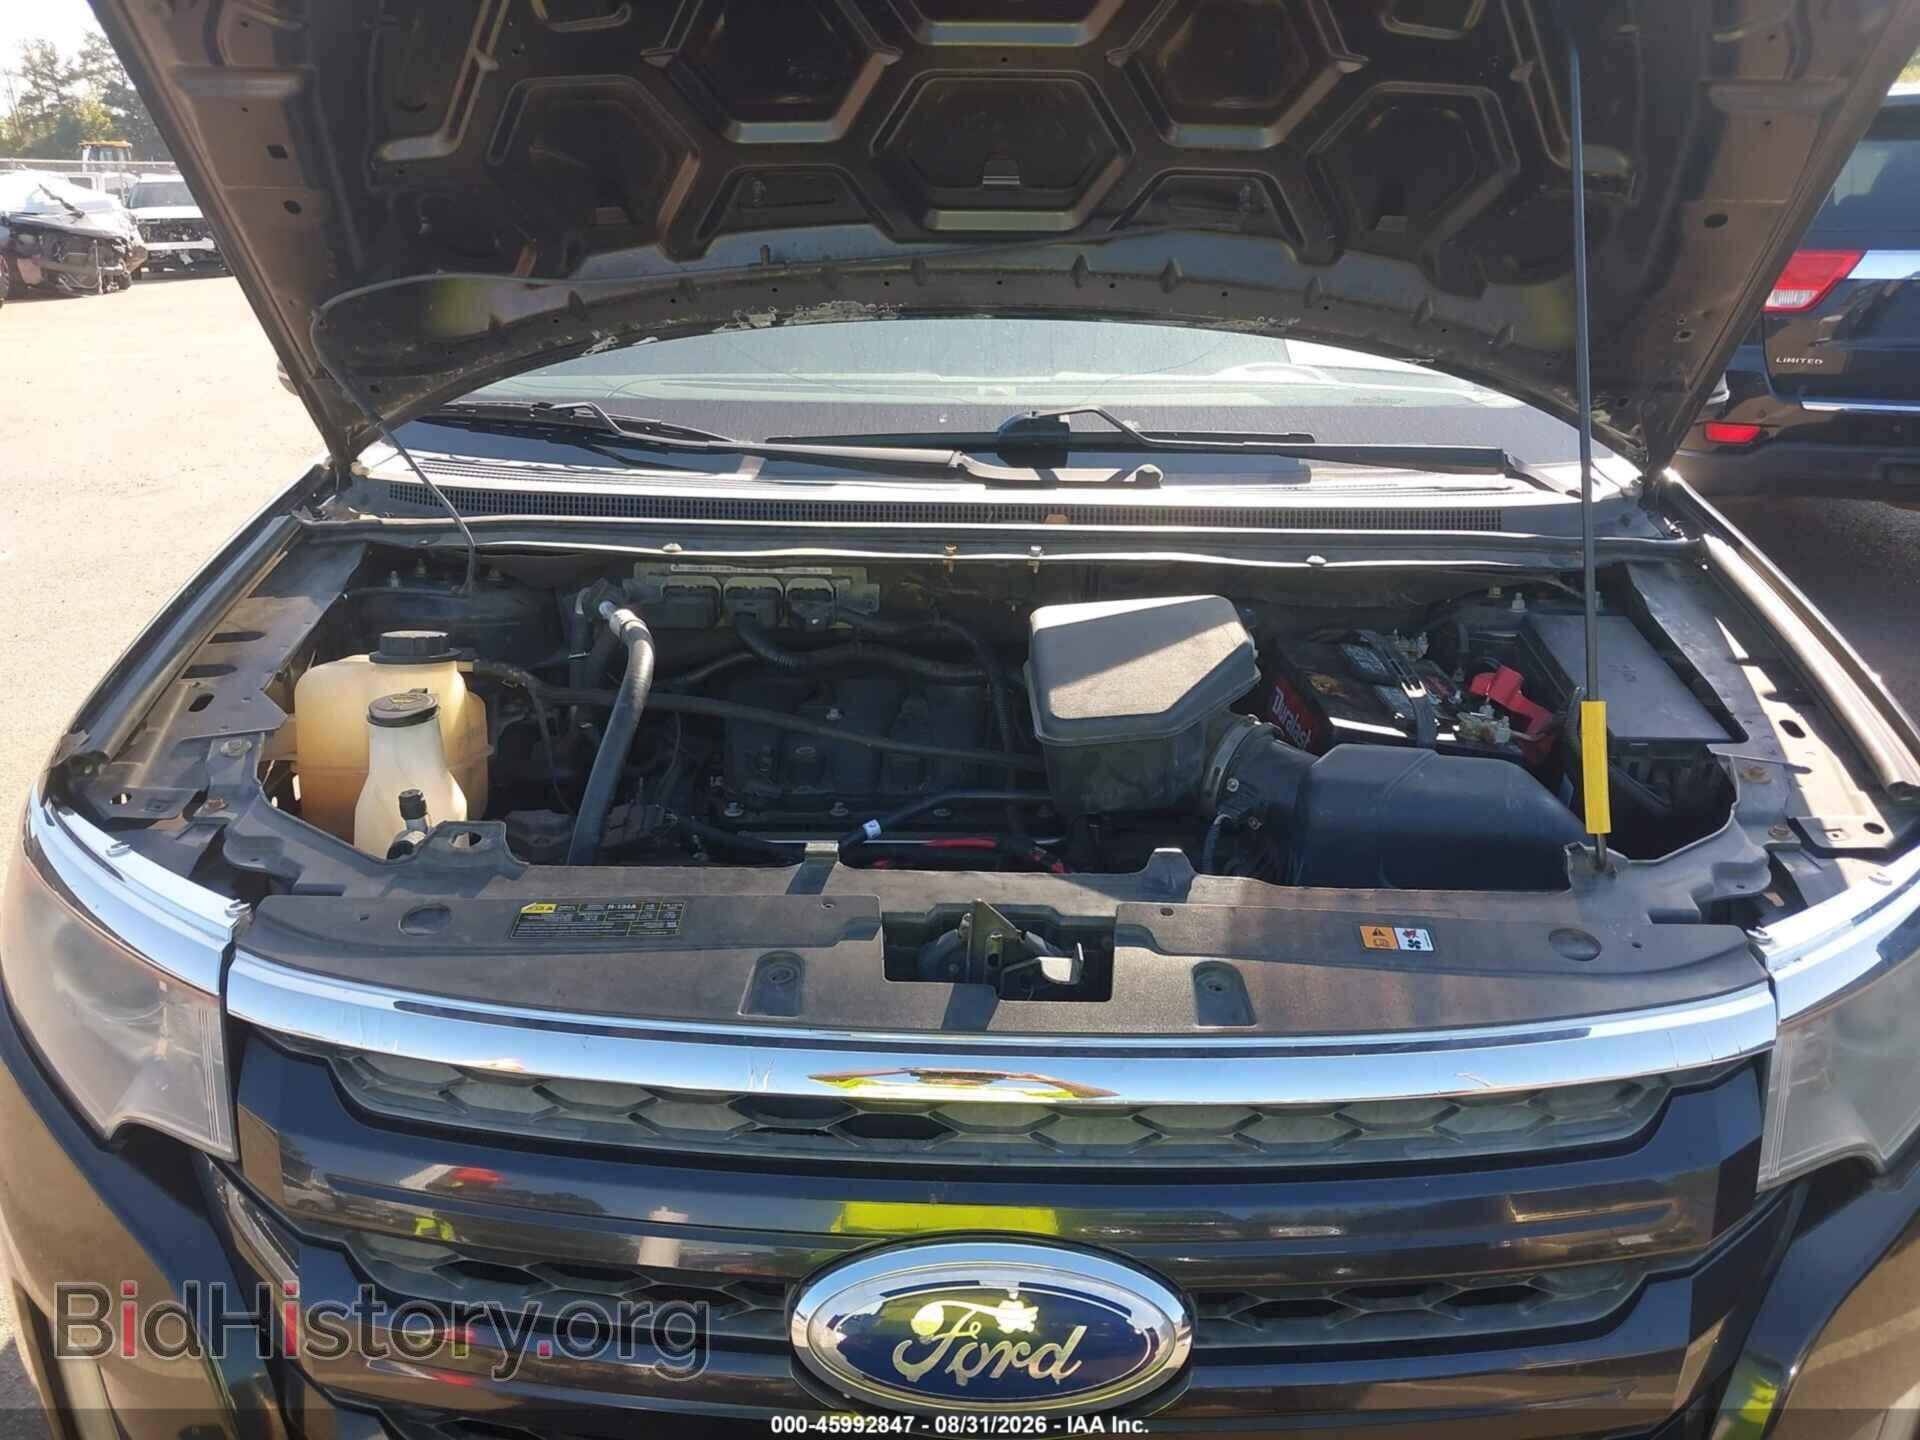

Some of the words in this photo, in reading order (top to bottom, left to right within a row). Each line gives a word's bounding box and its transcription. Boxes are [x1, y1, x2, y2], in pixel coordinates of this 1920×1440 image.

[1775, 357, 1824, 365] LIMITED
[1271, 685, 1313, 750] Duralast
[892, 1299, 1087, 1385] Ford
